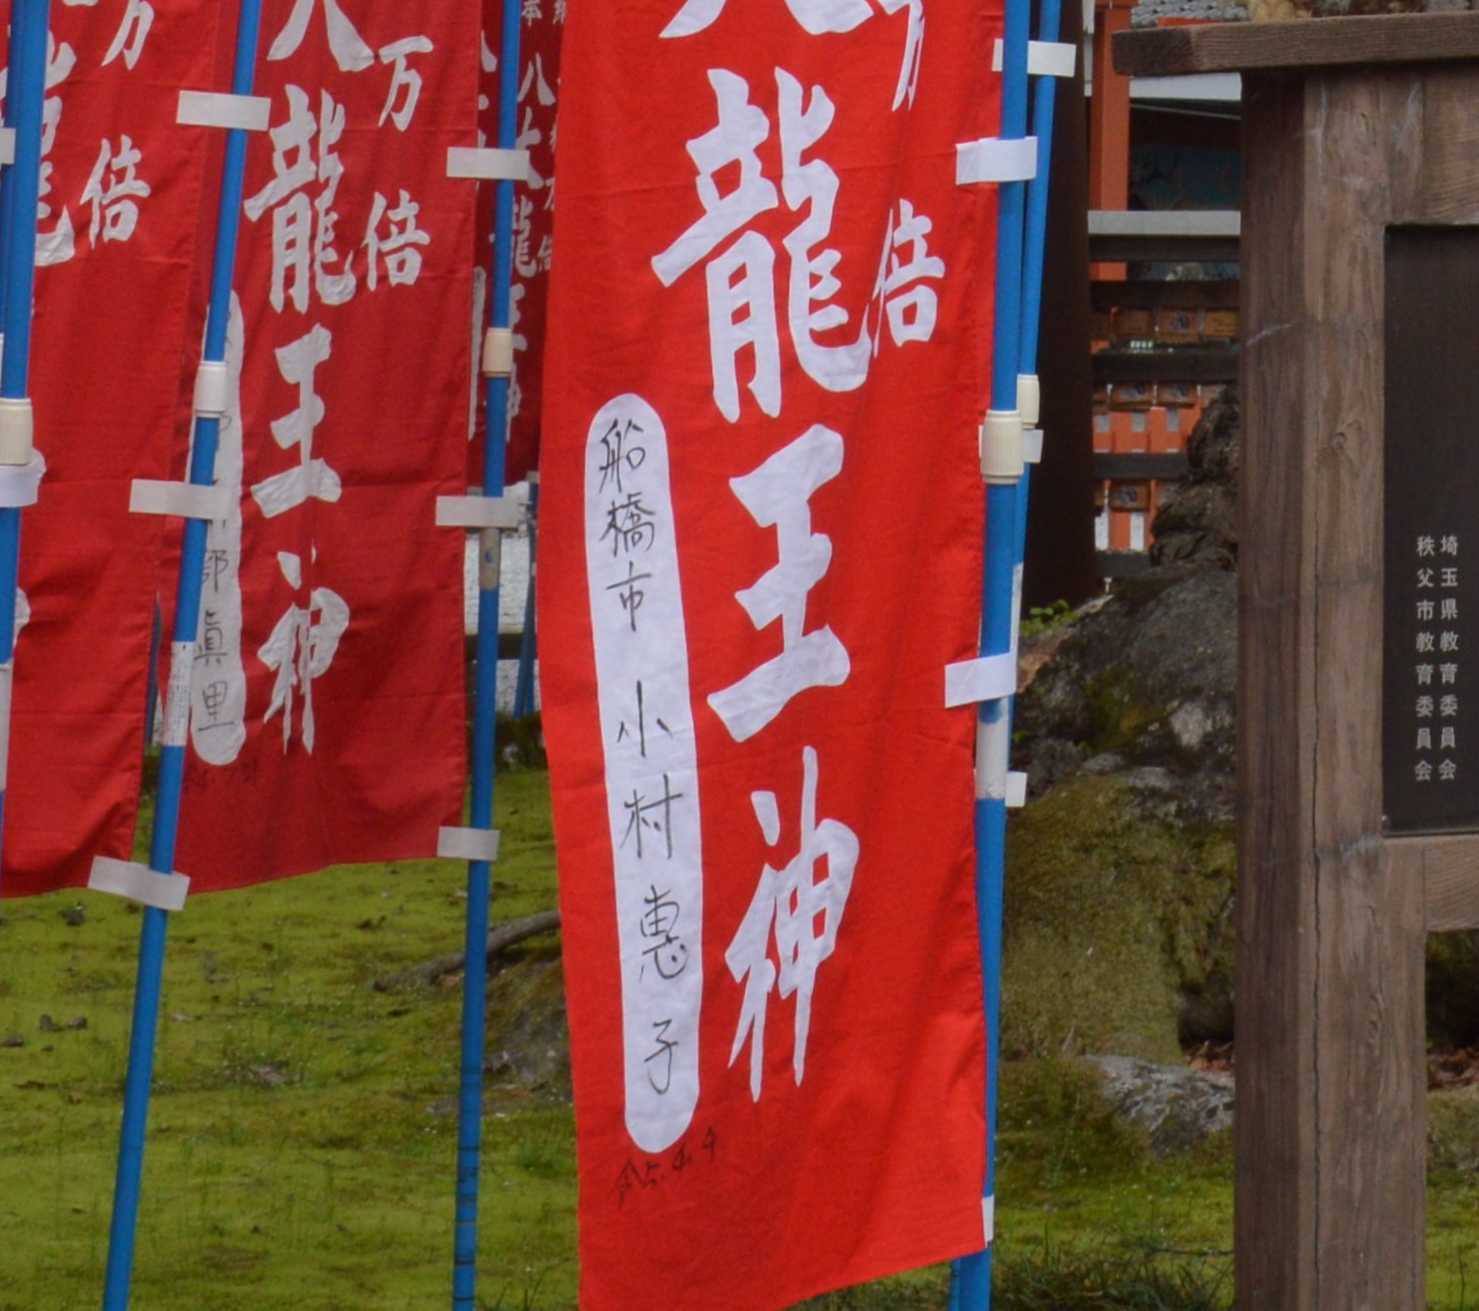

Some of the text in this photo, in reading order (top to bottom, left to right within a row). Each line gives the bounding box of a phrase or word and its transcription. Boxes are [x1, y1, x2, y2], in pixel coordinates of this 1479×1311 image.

[598, 417, 657, 633] 船橋市
[1413, 534, 1435, 782] 秩父市教育委員会
[1437, 534, 1459, 781] 埼玉県教育委員会
